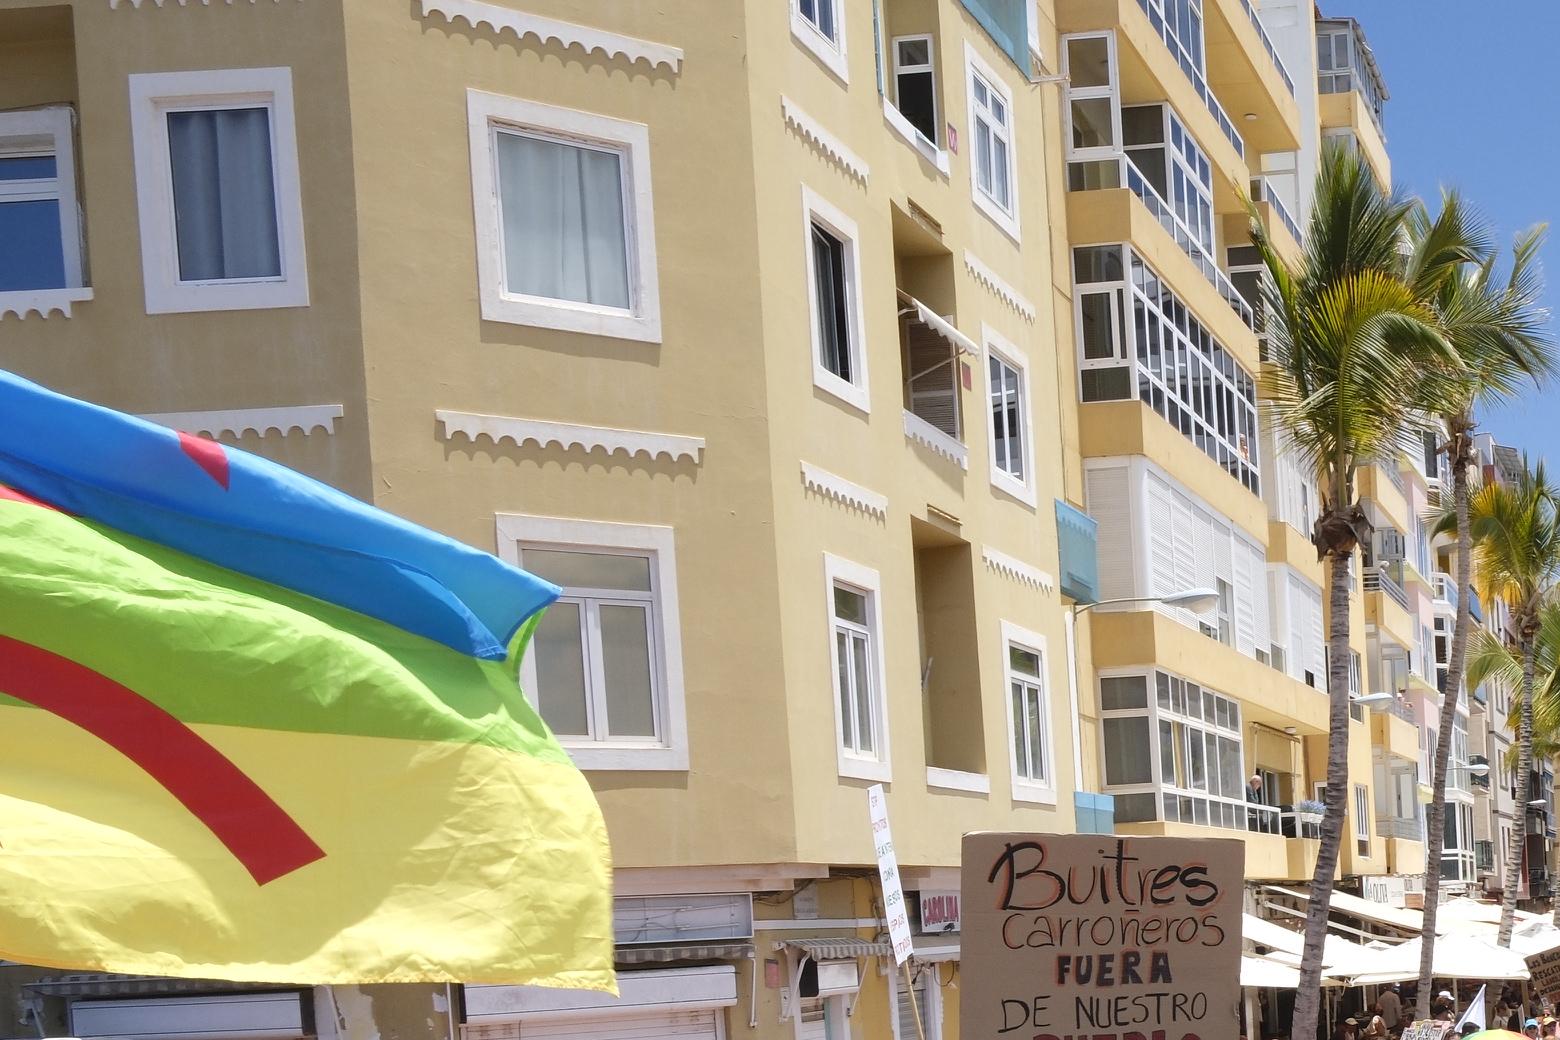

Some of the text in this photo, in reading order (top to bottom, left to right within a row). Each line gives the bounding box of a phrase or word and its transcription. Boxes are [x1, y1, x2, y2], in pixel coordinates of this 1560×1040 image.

[988, 839, 1220, 911] Buitres
[922, 896, 959, 926] CAROLINA
[1057, 950, 1173, 987] FUERA
[998, 992, 1208, 1033] DE NUESTRO
